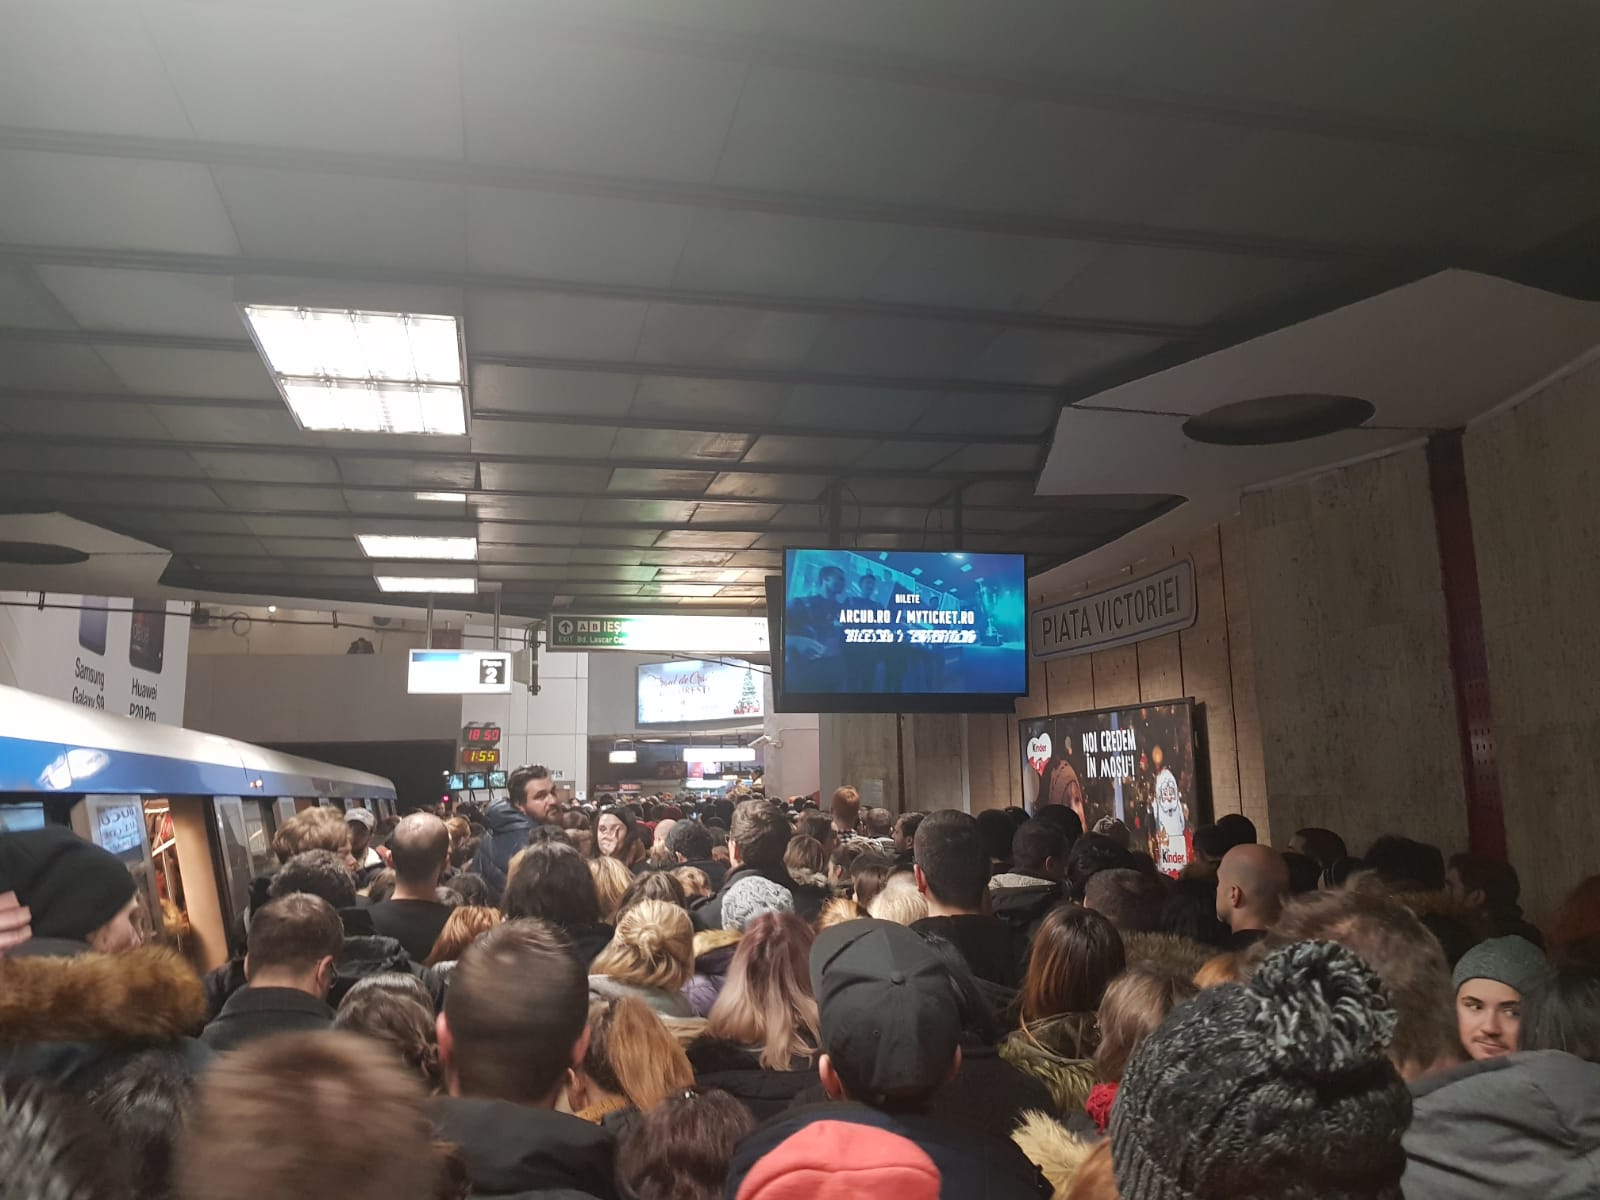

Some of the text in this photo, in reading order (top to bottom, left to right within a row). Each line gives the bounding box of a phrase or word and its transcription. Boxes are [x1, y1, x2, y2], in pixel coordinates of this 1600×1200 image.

[895, 594, 920, 604] BILETE
[1096, 575, 1180, 634] VICTORIEI
[896, 610, 902, 623] /
[906, 610, 975, 625] MYTICKET.RO
[75, 657, 105, 691] Samsung
[485, 667, 498, 682] 2
[131, 677, 158, 701] Huawei
[1082, 729, 1137, 753] NOI CREDEM
